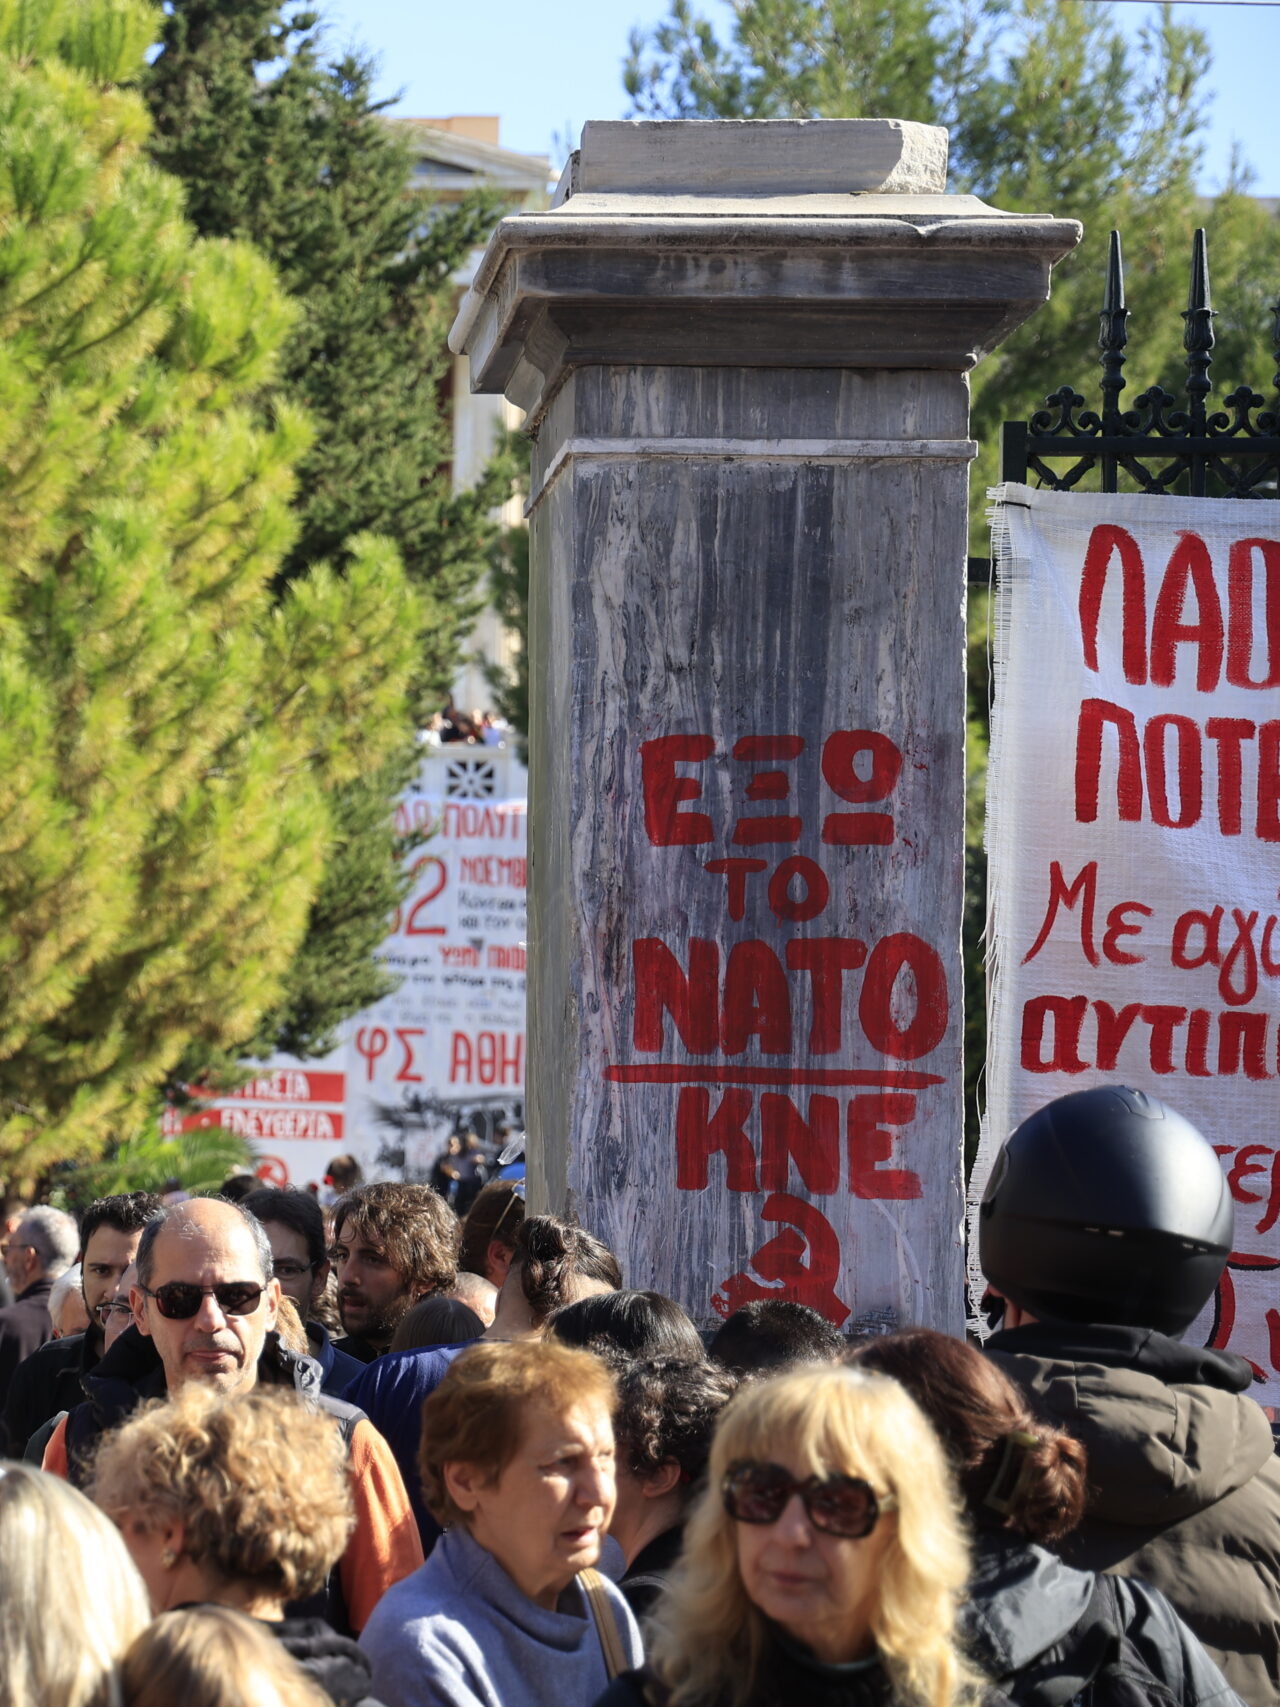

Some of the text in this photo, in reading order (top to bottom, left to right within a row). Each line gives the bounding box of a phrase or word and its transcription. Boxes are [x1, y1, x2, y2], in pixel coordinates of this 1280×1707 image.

[1020, 860, 1154, 969] Με
[632, 932, 948, 1060] ΝΑΤΟ
[1020, 995, 1280, 1081] αντιπ
[676, 1086, 922, 1200] ΚΝΕ
